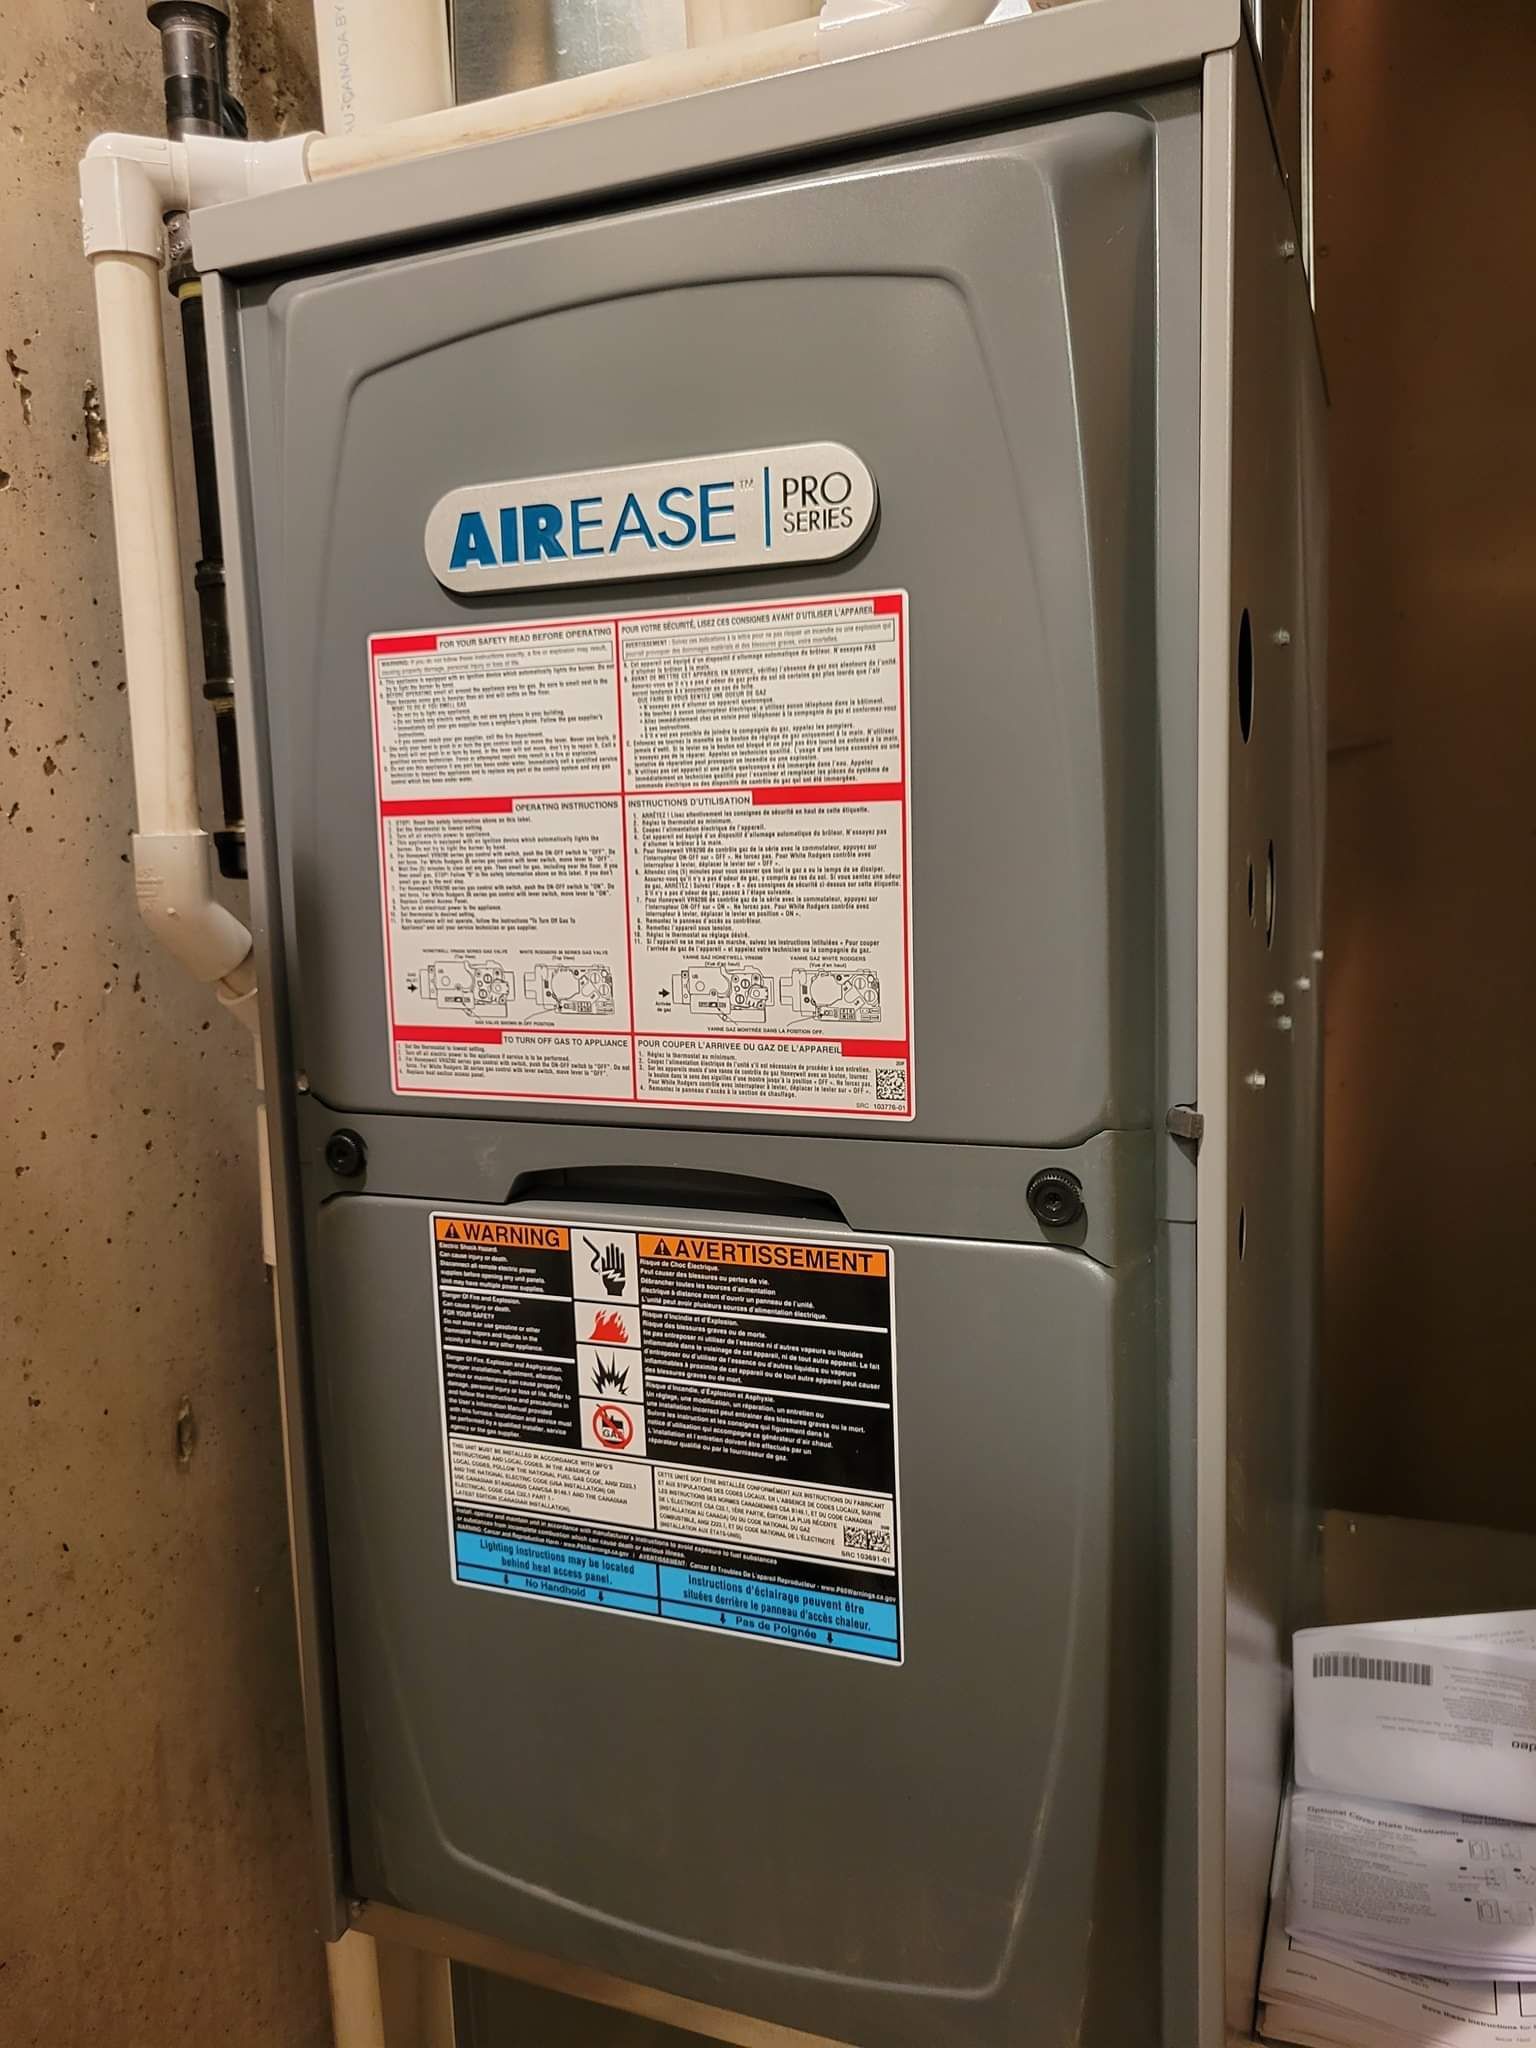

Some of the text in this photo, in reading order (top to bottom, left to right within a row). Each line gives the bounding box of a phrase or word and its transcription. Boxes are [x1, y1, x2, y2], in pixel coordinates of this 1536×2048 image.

[449, 481, 736, 569] AIREASE
[782, 472, 852, 507] PRO
[783, 507, 853, 533] SERIES
[514, 800, 618, 811] OPERATING INSTRUCTIONS
[627, 796, 750, 808] INSTRUCTIONS D'UTILISATION
[503, 1035, 627, 1047] TO TURN OFF GAS TO APPLIANCE
[637, 1039, 660, 1047] POUR
[662, 1040, 695, 1048] COUPER
[757, 1043, 775, 1051] GAZ
[777, 1044, 788, 1052] DE
[791, 1044, 841, 1054] L'APPAREIL
[463, 1223, 560, 1247] WARNING
[675, 1239, 873, 1273] AVERTISSEMENT
[479, 1538, 634, 1574] Lighting instructions may be located
[501, 1555, 612, 1584] behind heat access panel.
[525, 1578, 586, 1597] No Handhold
[688, 1574, 864, 1614] Instructions d'éclairage peuvent être
[683, 1589, 870, 1631] situées derrière le panneau d'accès chaleur.
[735, 1615, 817, 1639] Pas de Poignée
